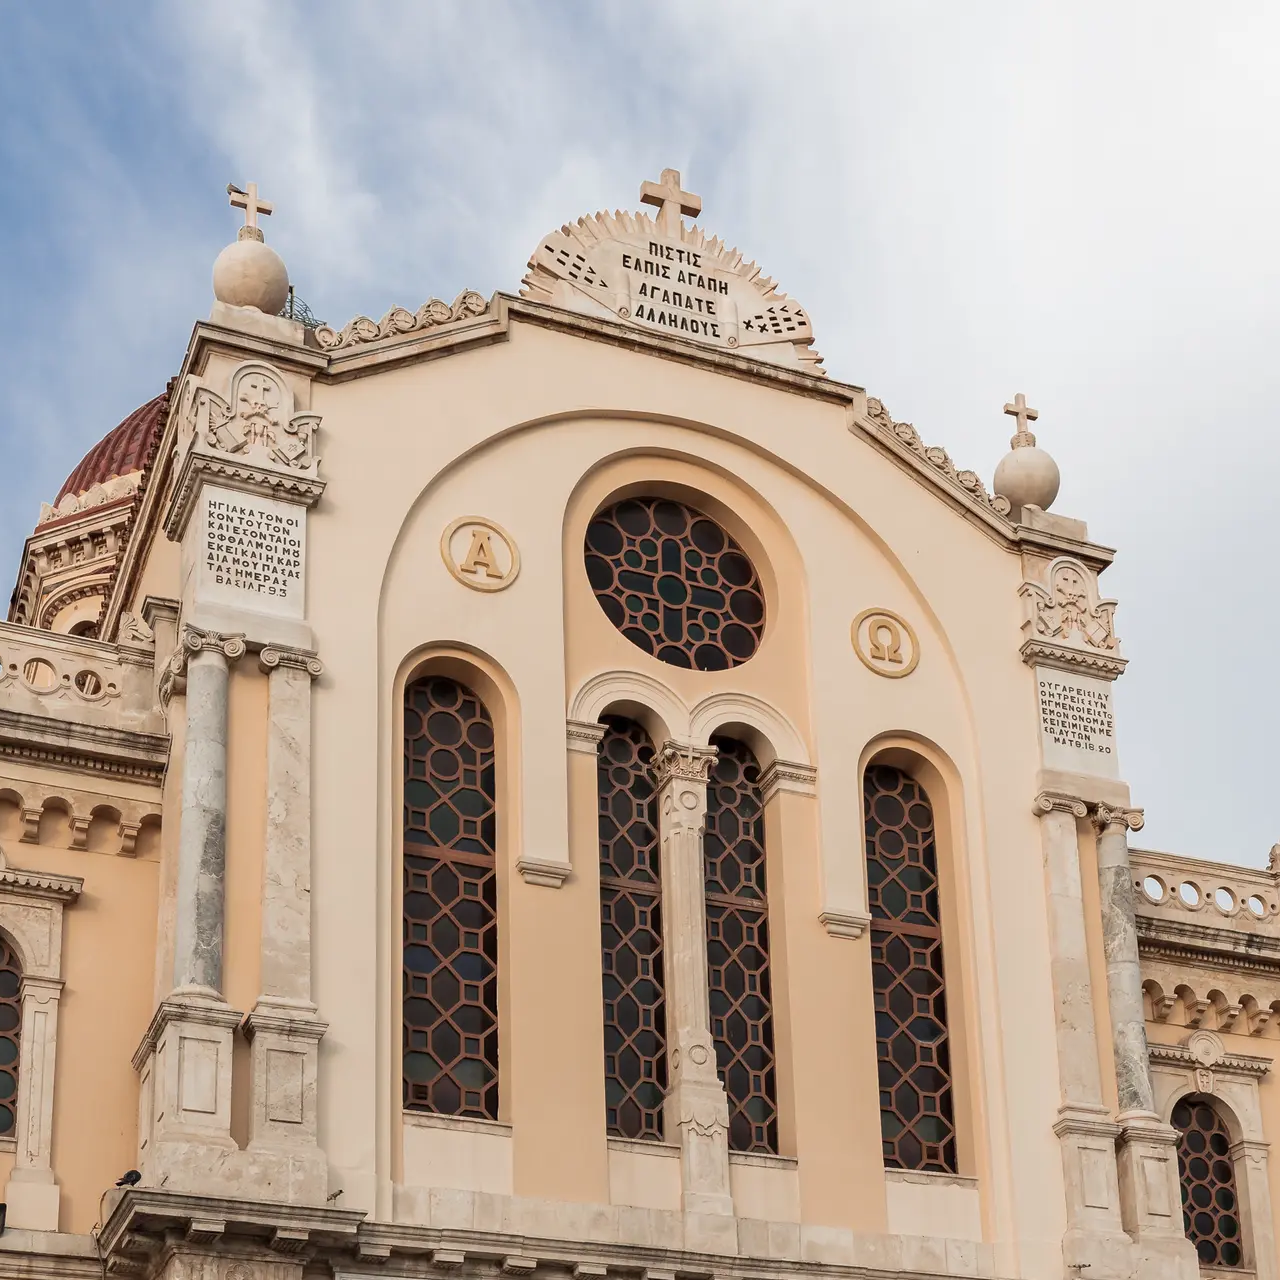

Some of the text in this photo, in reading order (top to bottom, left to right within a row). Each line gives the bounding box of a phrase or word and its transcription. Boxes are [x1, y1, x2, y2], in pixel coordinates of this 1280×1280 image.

[649, 242, 701, 268] ΠΙΣΤΙΣ
[623, 254, 728, 295] ΕΛΠΙΣ ΑΓΑΠΗ
[639, 283, 716, 315] ΑΓΑΠΑΤΕ
[635, 305, 720, 338] ΑΛΛΗΛΟΥΣ
[208, 521, 229, 532] ΚΑΙ
[209, 501, 298, 527] ΗΓΙΑΚΑ ΤΟΝ ΟΙ
[209, 510, 290, 535] ΚΟΝ ΤΟΥΤΟΝ
[208, 532, 277, 553] ΟΦΘΑΛΜΟΙ
[208, 542, 237, 555] ΕΚΕΙ
[277, 557, 300, 567] ΚΑΡ
[207, 562, 287, 586] ΤΑΣ ΗΜΕΡΑΣ
[208, 552, 300, 579] ΔΙΑ ΜΟΥ ΠΑΣΑΣ
[869, 617, 903, 664] Ω
